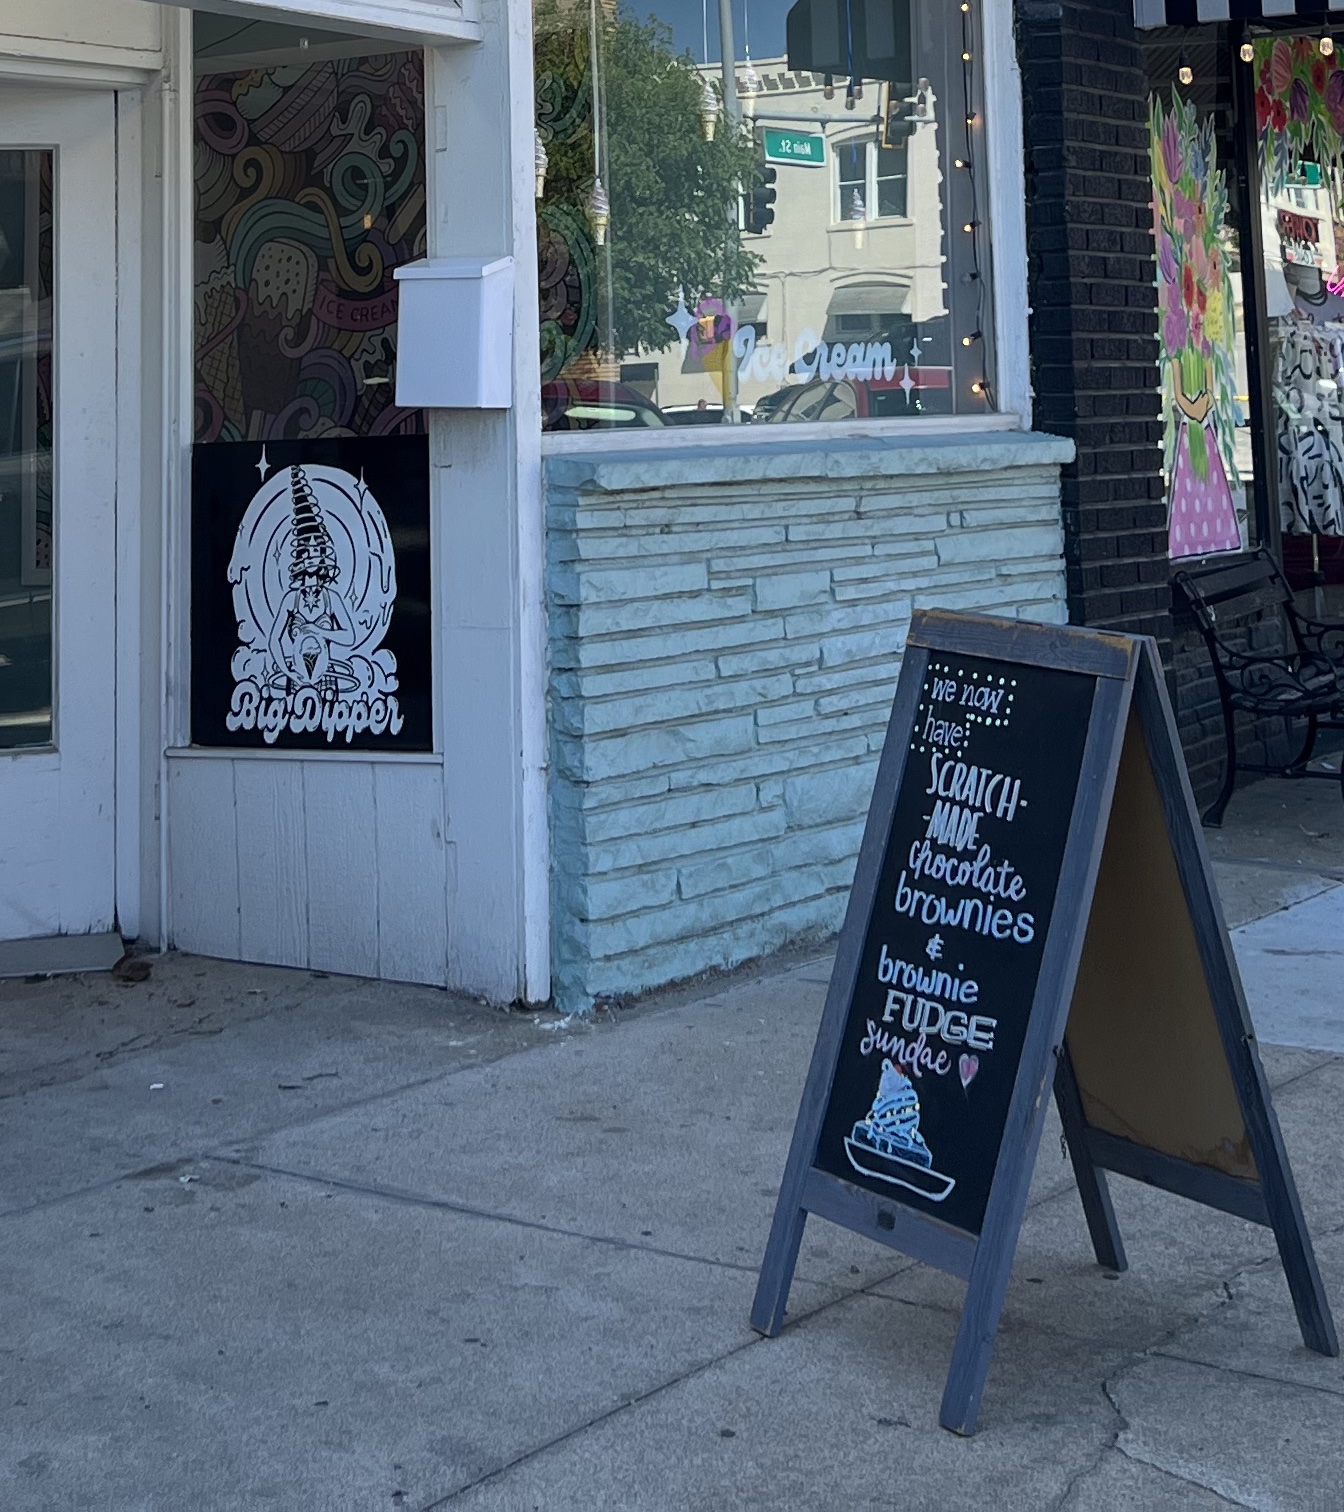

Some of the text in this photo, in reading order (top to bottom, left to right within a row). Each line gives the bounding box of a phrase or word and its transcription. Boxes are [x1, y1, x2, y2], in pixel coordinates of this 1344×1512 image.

[319, 296, 343, 320] ICE
[733, 324, 896, 384] Ice Cream
[226, 680, 405, 744] Big Dipper
[922, 704, 964, 747] have
[931, 677, 1004, 714] we now
[895, 869, 1035, 944] brownies
[877, 944, 979, 1004] brownie
[882, 989, 998, 1052] FUDGE
